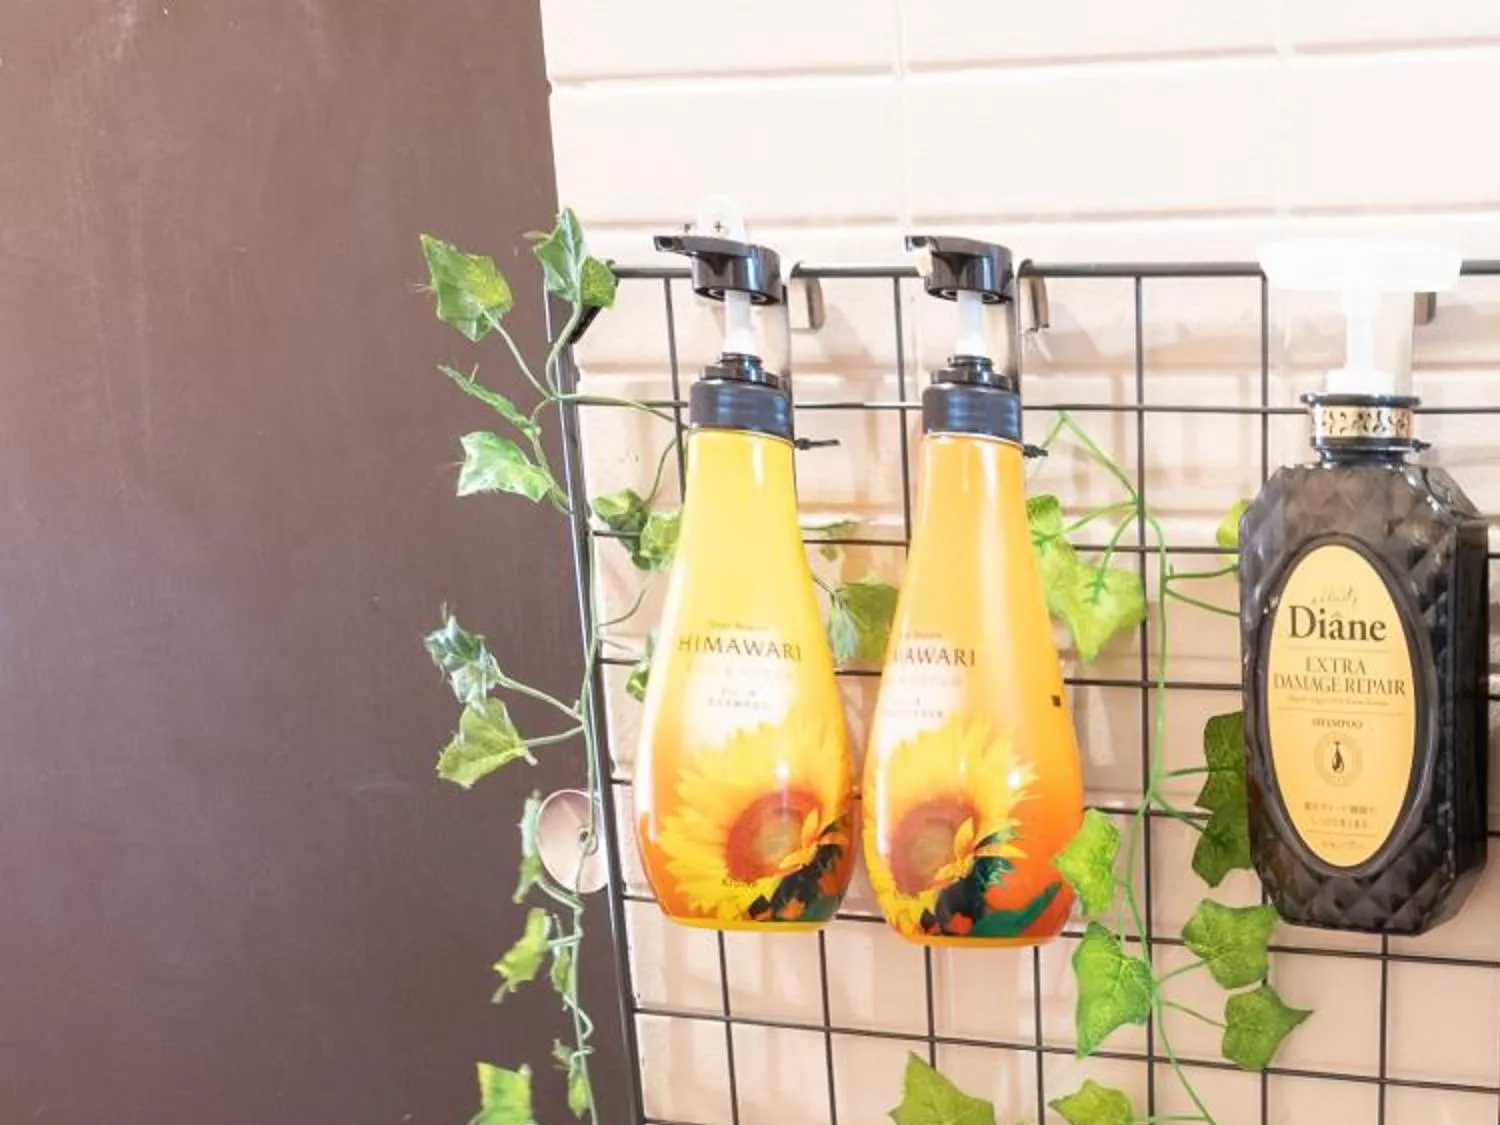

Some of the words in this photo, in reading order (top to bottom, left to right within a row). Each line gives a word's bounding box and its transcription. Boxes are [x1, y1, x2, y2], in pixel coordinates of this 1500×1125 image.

[1288, 603, 1388, 643] Diâne
[678, 633, 803, 661] HIMAWARI
[893, 646, 977, 668] AWARI
[1304, 655, 1367, 676] EXTRA
[1273, 671, 1342, 694] DAMAGE
[1344, 676, 1406, 697] REPAIR
